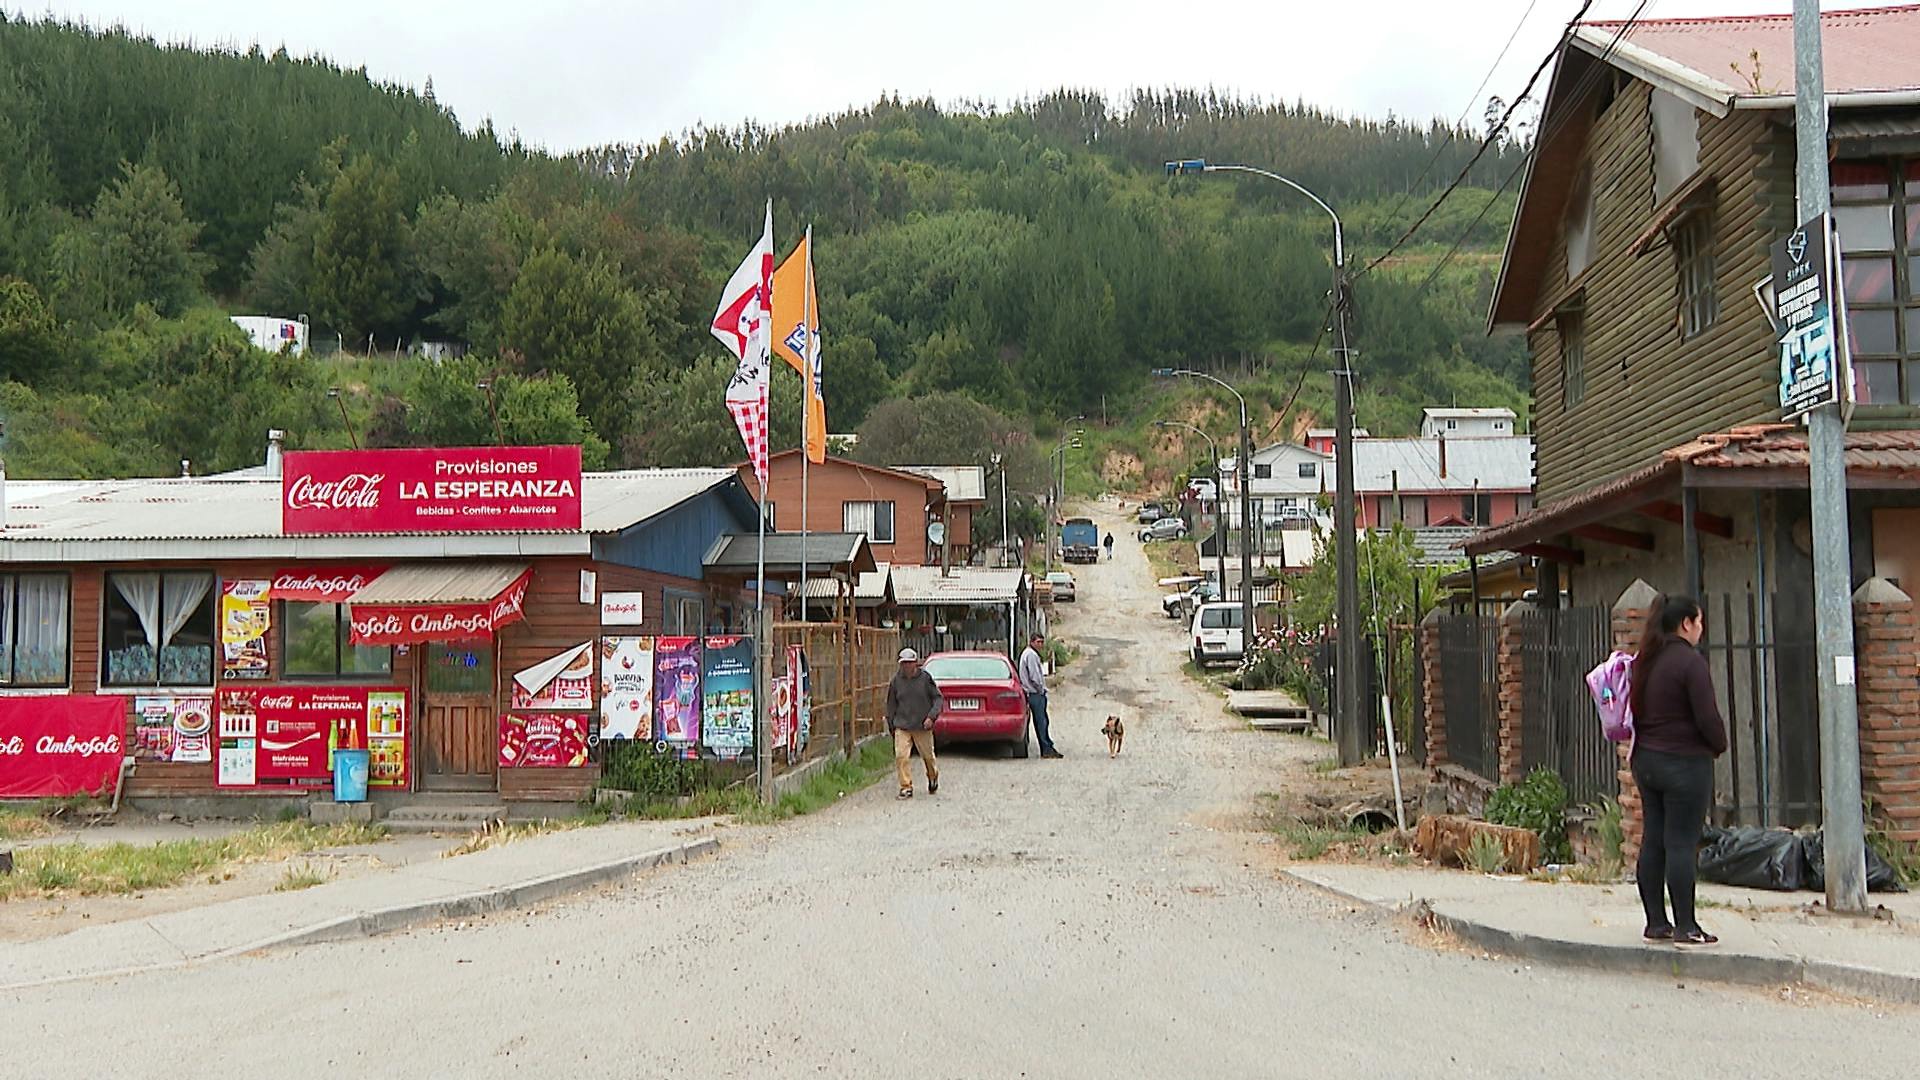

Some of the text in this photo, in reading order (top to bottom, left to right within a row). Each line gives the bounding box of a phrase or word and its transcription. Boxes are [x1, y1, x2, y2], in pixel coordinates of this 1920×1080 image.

[435, 459, 538, 475] Provisiones
[288, 473, 385, 510] Coca-Cola
[399, 480, 575, 499] LA ESPERANZA
[416, 504, 557, 516] Bebidas Confites Abarrotes
[299, 702, 363, 710] LA ESPERANZA
[36, 734, 121, 756] Ambrosoli
